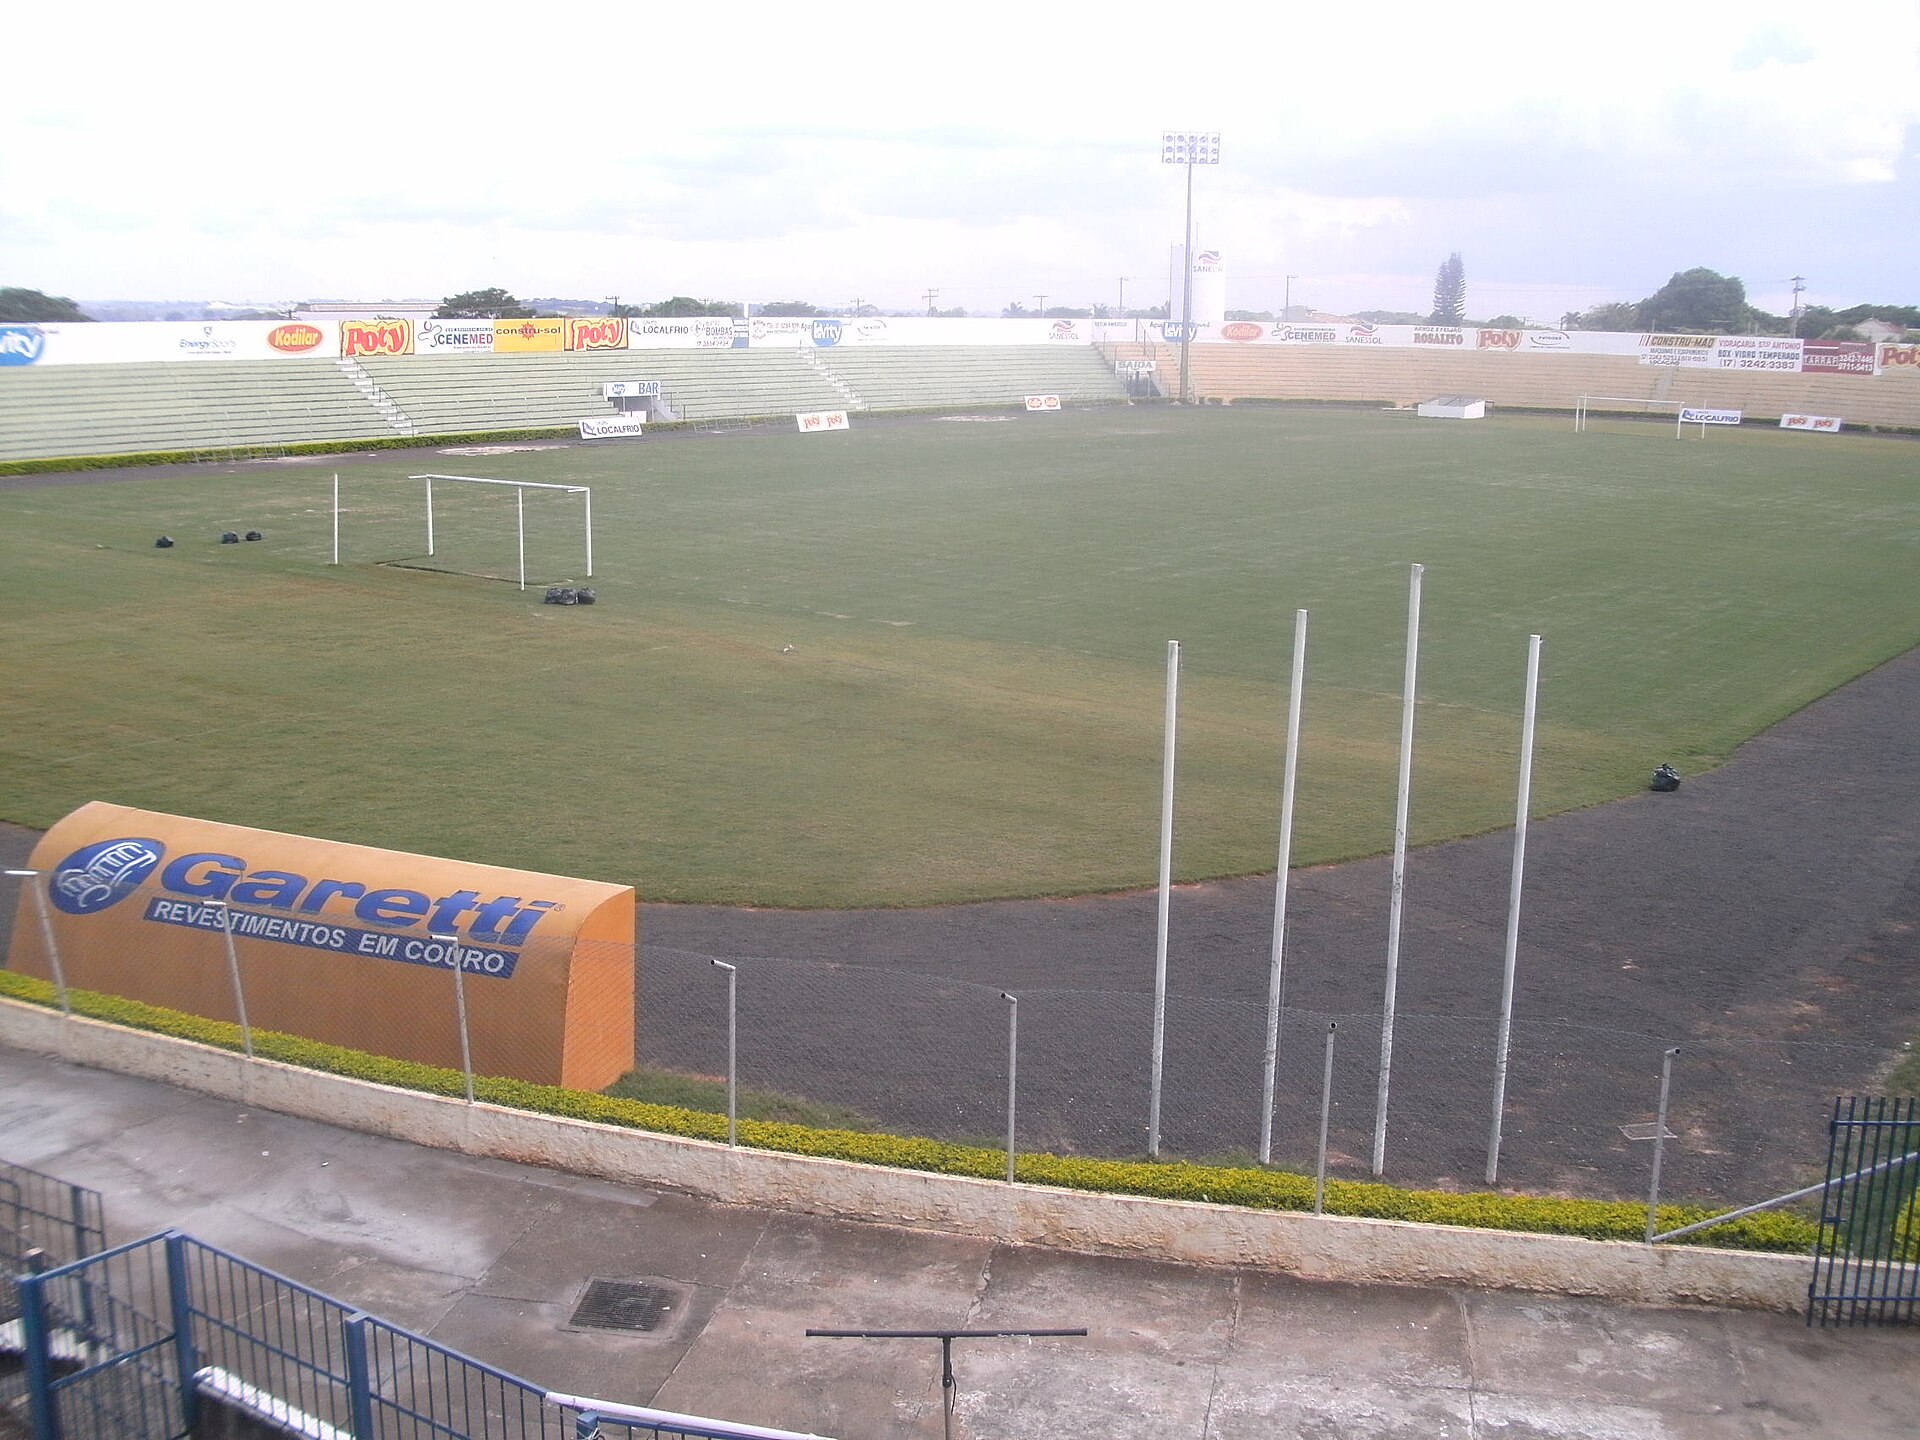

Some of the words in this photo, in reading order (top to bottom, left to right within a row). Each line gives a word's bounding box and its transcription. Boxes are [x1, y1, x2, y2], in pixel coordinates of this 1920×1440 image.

[495, 325, 561, 335] constru-sol
[643, 326, 688, 334] LOCALFRIO
[706, 326, 733, 336] BOMBAS
[275, 327, 318, 347] Kodilar
[438, 334, 493, 344] CENEMED
[1288, 331, 1336, 340] CENEMED
[1345, 336, 1382, 344] SANESSOL
[1413, 332, 1464, 345] ROSALITO
[1735, 350, 1756, 358] VIDRO
[1760, 351, 1800, 360] TEMPERADO
[1720, 358, 1736, 367] (17)
[1740, 359, 1795, 369] 3242-3383
[639, 382, 660, 394] BAR
[1695, 414, 1739, 422] LOCALFRIO
[597, 424, 640, 435] LOCALFRIO
[160, 853, 556, 948] Garetti
[153, 901, 346, 948] REVESTIMENTOS
[358, 933, 399, 956] EM
[405, 940, 505, 974] COURO
